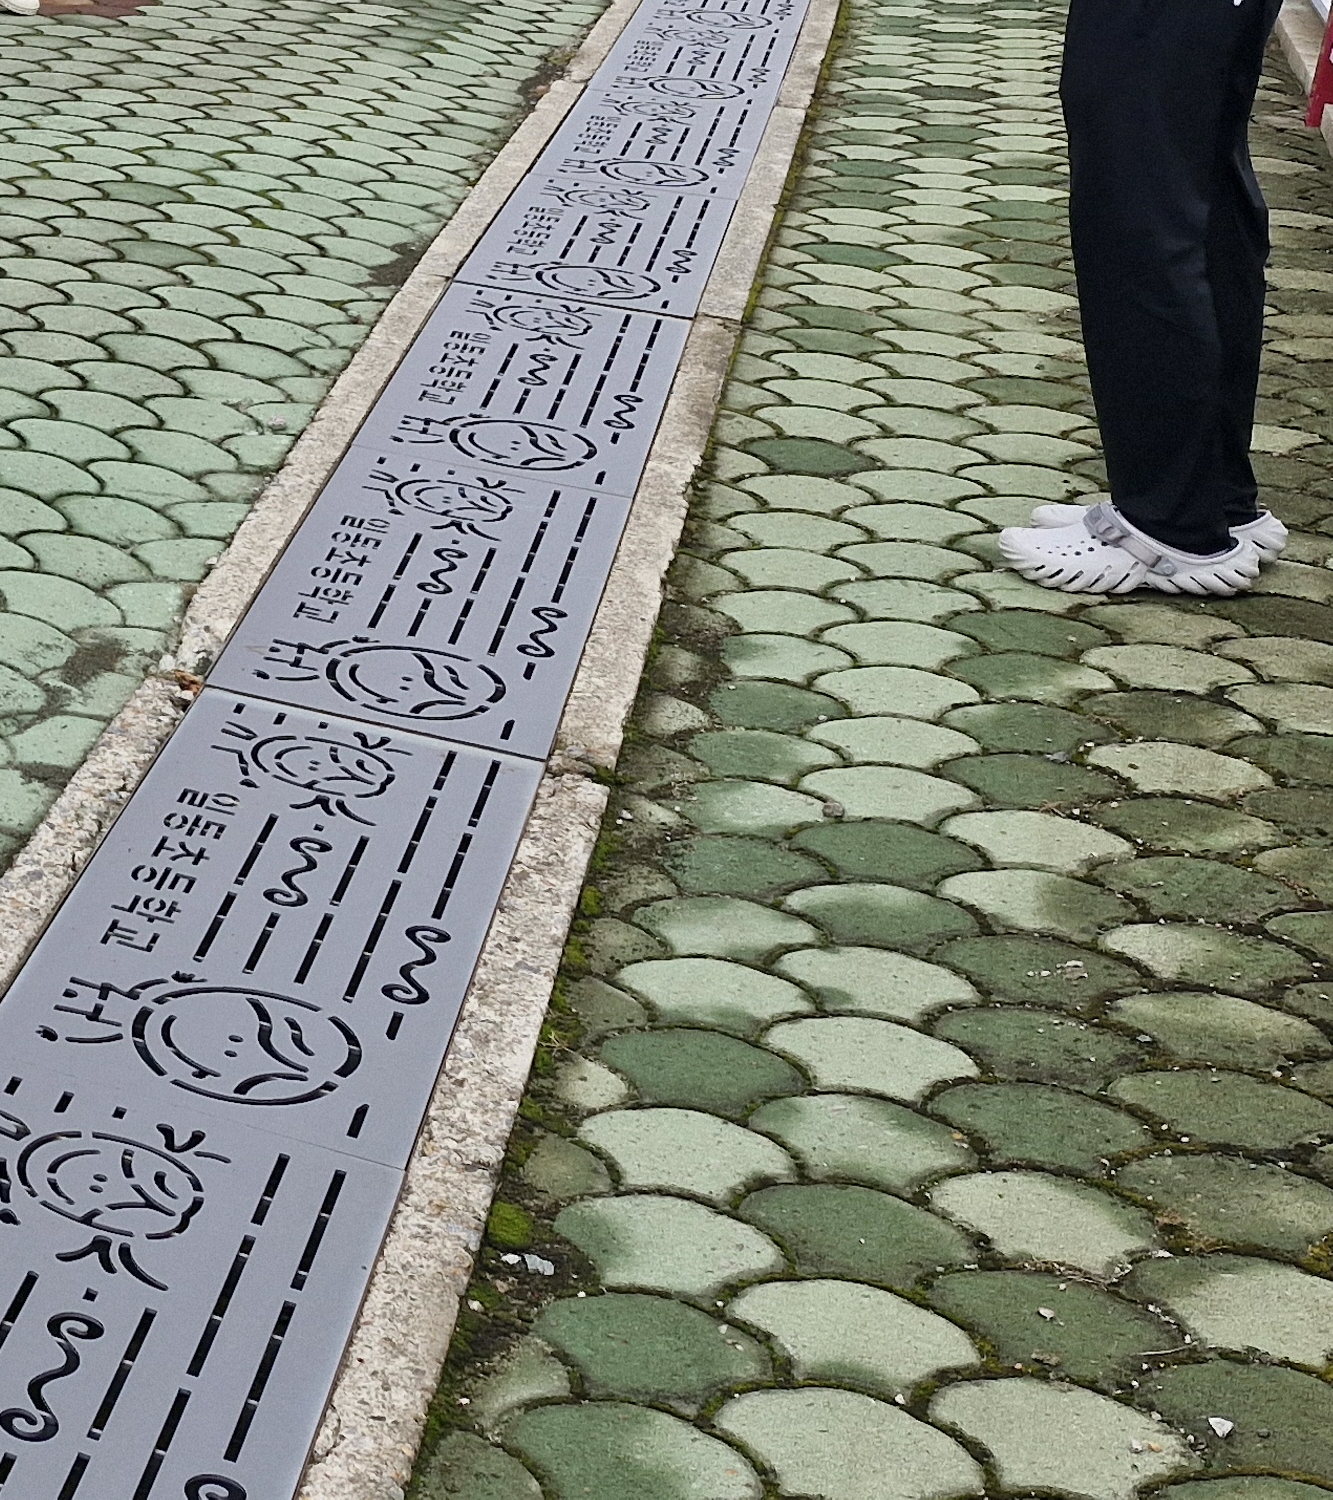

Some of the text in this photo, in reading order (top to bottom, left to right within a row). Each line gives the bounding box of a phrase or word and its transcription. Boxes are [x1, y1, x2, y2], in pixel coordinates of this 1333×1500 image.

[507, 206, 564, 256] 일동초등학교
[418, 330, 492, 405] 일동초등학교
[290, 515, 391, 624] 일동초등학교
[99, 786, 240, 953] 일동초등학교
